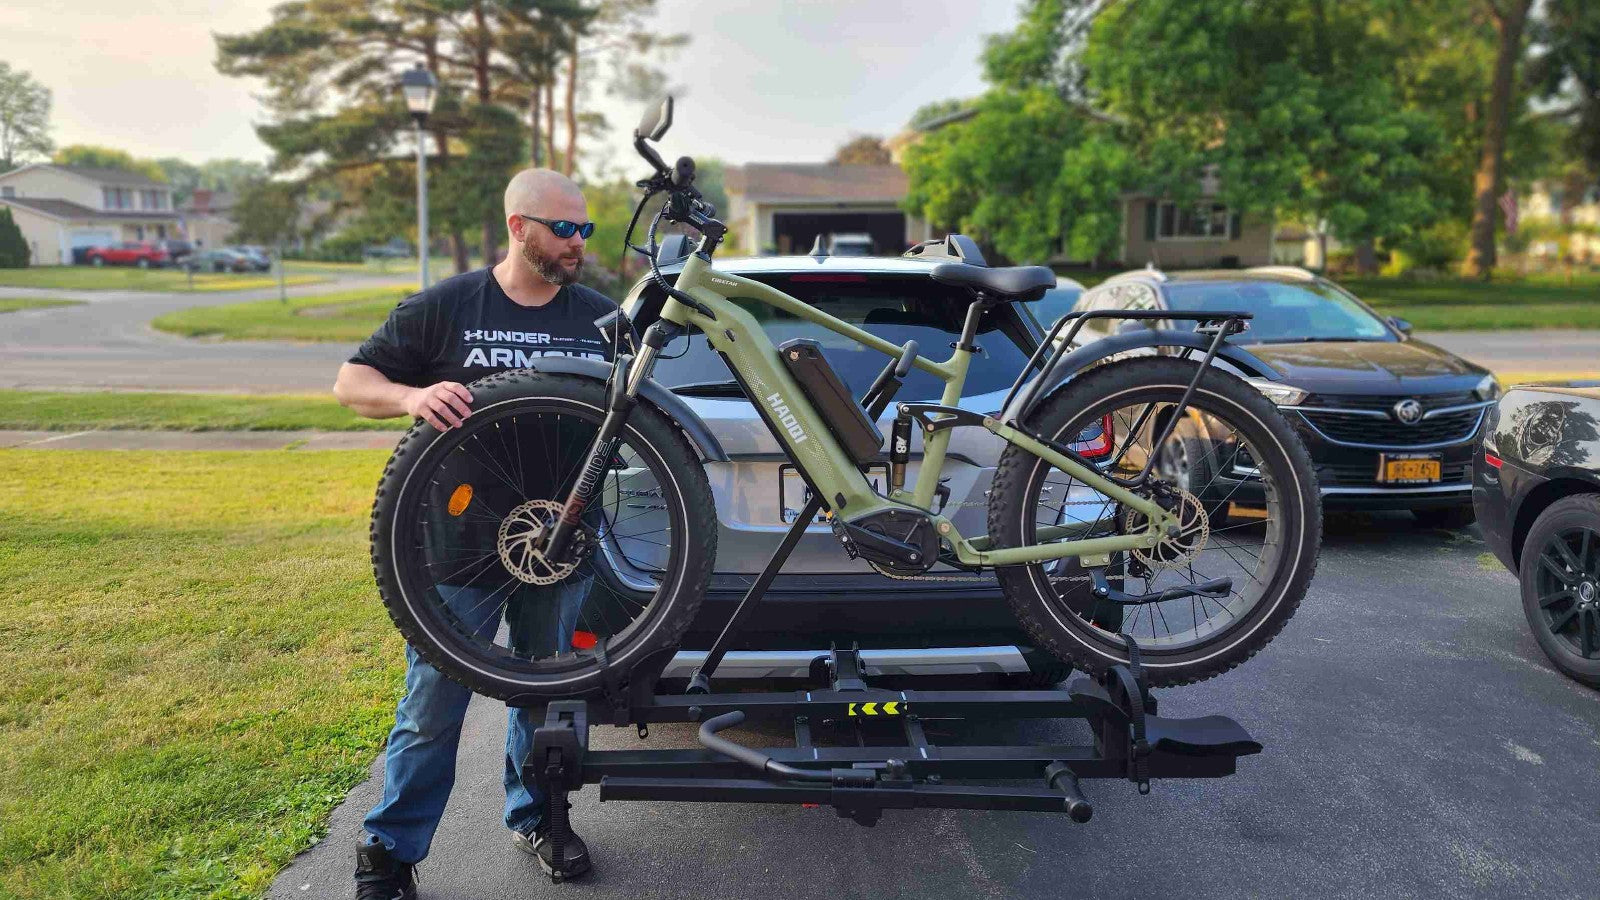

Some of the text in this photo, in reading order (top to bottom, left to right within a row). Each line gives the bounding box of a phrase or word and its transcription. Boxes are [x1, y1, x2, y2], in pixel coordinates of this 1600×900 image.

[484, 330, 551, 344] UNDER
[463, 347, 604, 368] ARM
[767, 392, 808, 445] HAOQI
